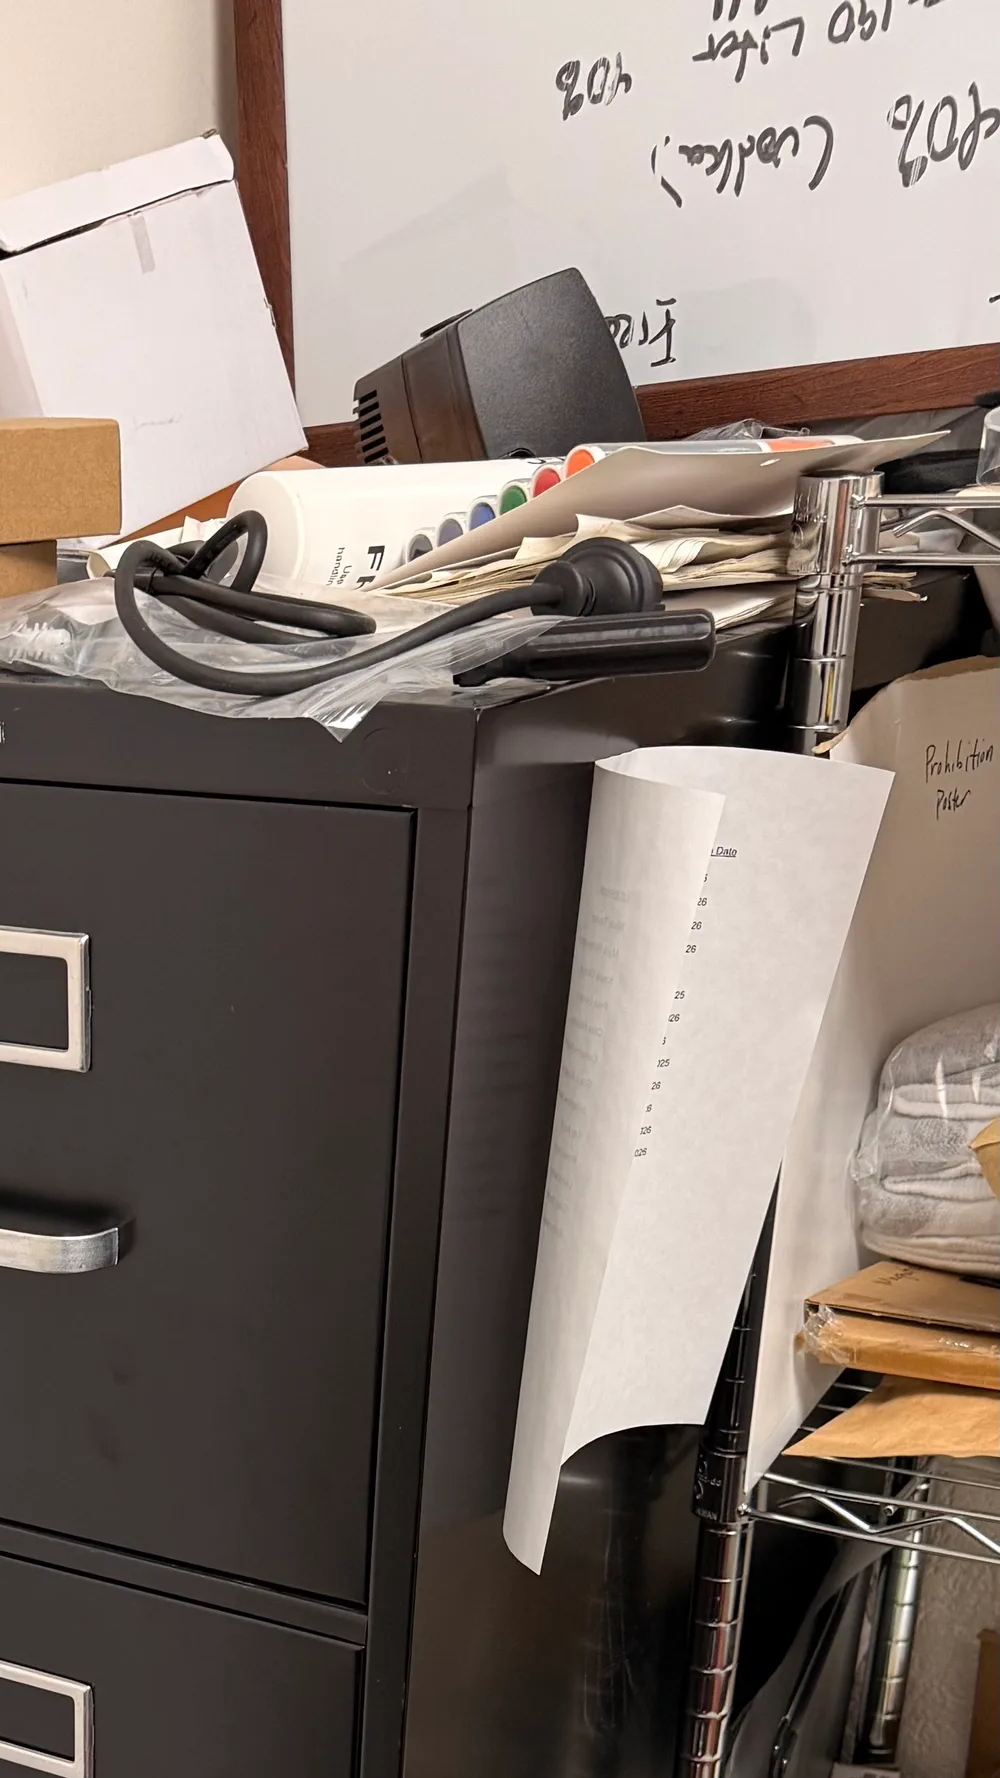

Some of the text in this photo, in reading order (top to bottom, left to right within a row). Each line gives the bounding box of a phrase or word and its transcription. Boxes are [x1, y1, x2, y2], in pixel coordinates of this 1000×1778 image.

[692, 16, 805, 83] Liter
[336, 565, 352, 585] Use
[925, 737, 994, 783] Prohibition
